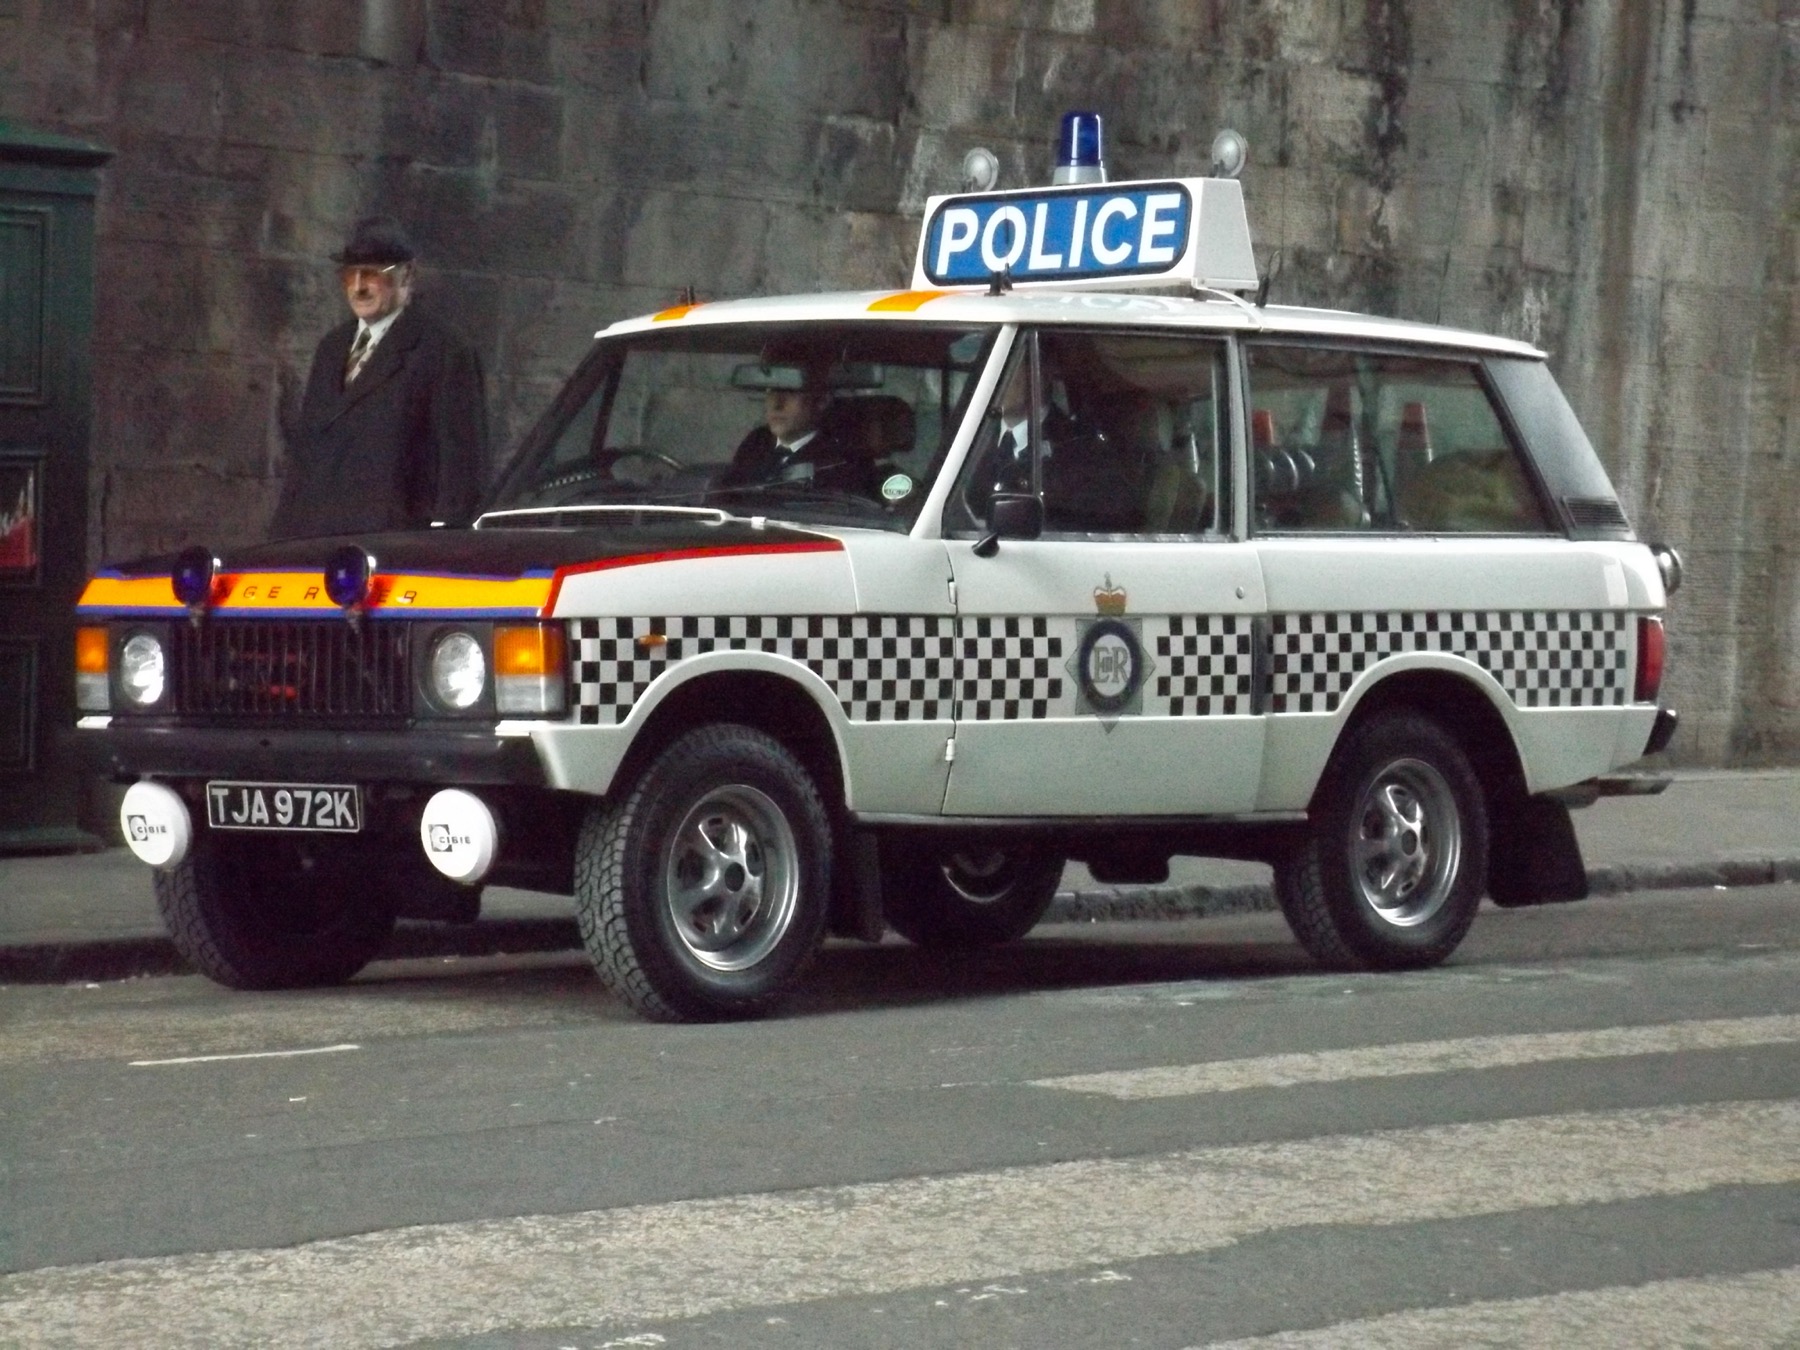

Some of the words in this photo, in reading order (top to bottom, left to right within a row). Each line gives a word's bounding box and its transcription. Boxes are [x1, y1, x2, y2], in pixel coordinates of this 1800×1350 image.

[936, 193, 1181, 275] POLICE
[303, 586, 417, 604] RER
[136, 825, 167, 834] CIBIE
[439, 836, 471, 844] CIBIE
